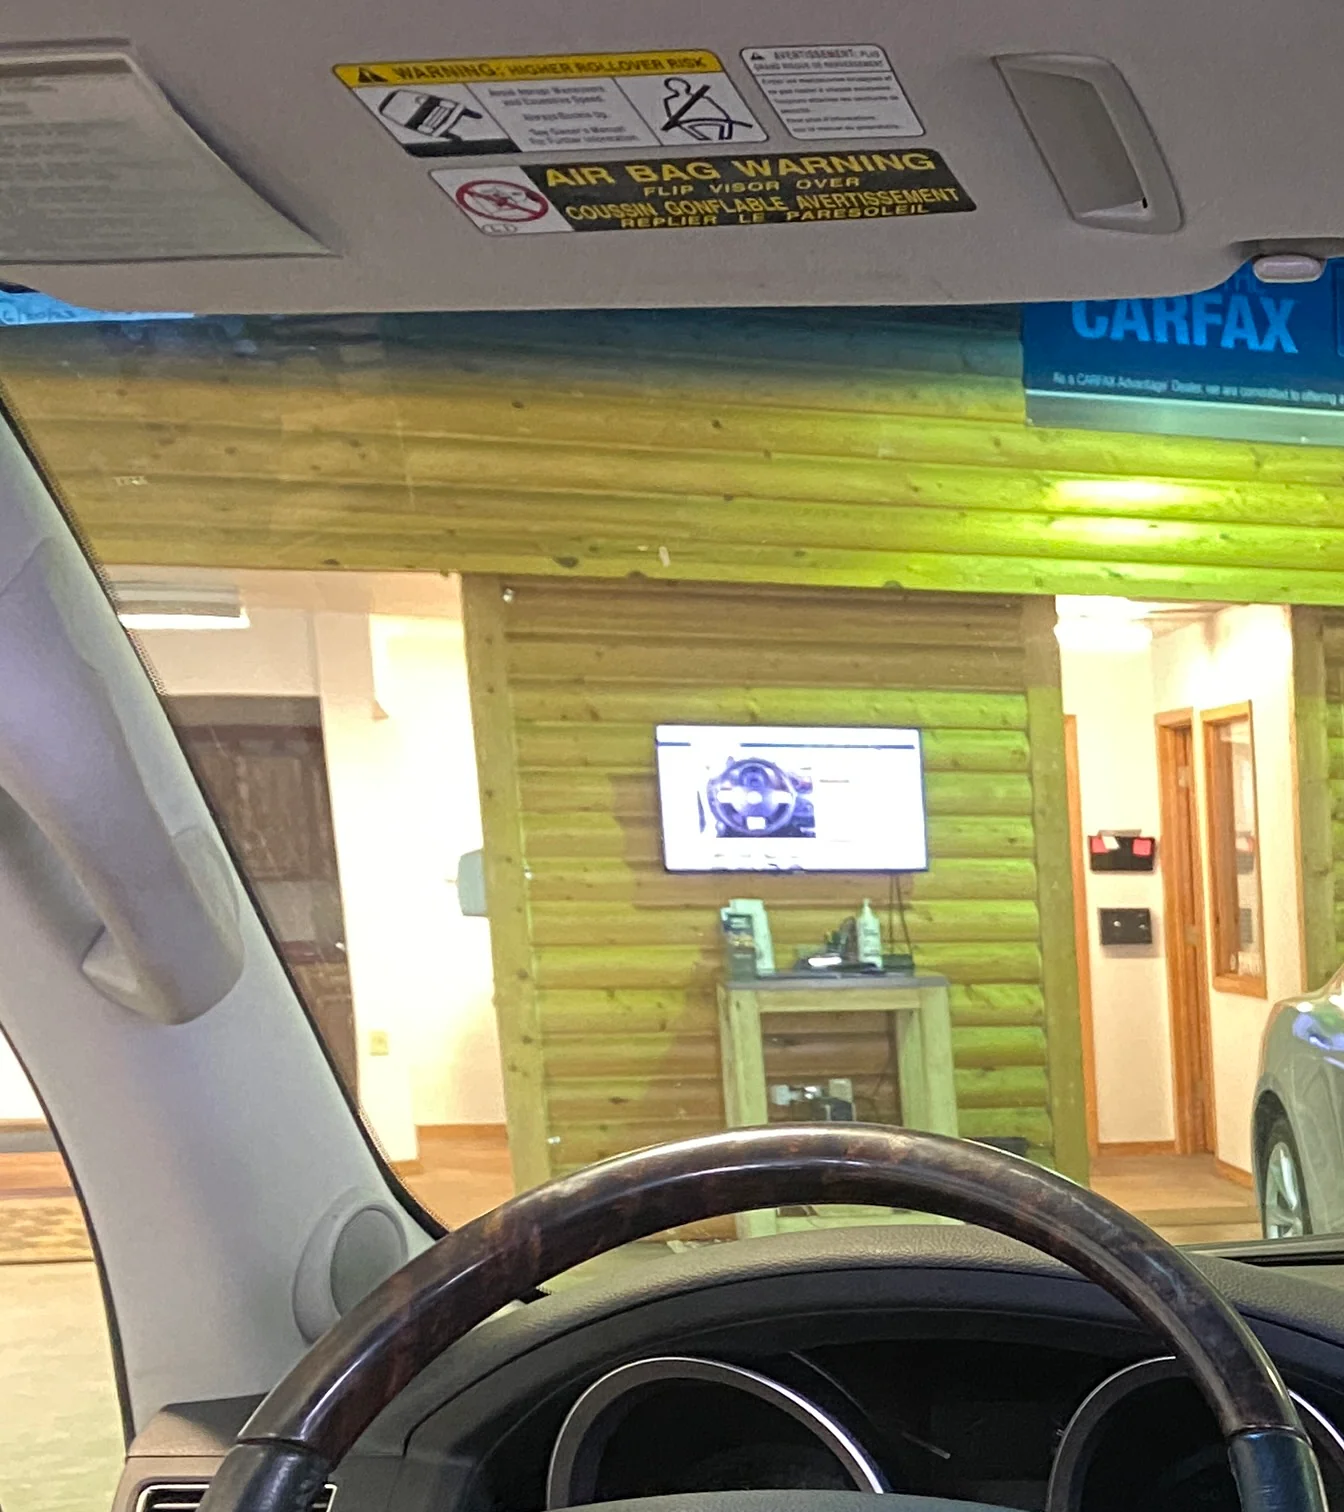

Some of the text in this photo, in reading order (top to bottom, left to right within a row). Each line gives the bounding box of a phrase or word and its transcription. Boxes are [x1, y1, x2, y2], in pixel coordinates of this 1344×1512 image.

[546, 152, 936, 187] AIR BAG WARNING
[565, 187, 960, 221] COUSSIN GONFLABLE AVERTISSEMENT
[644, 177, 861, 197] FLIP VISOR OVER
[621, 203, 930, 229] REPLIER LE PARESOLEIL
[1072, 293, 1298, 353] CARFAX
